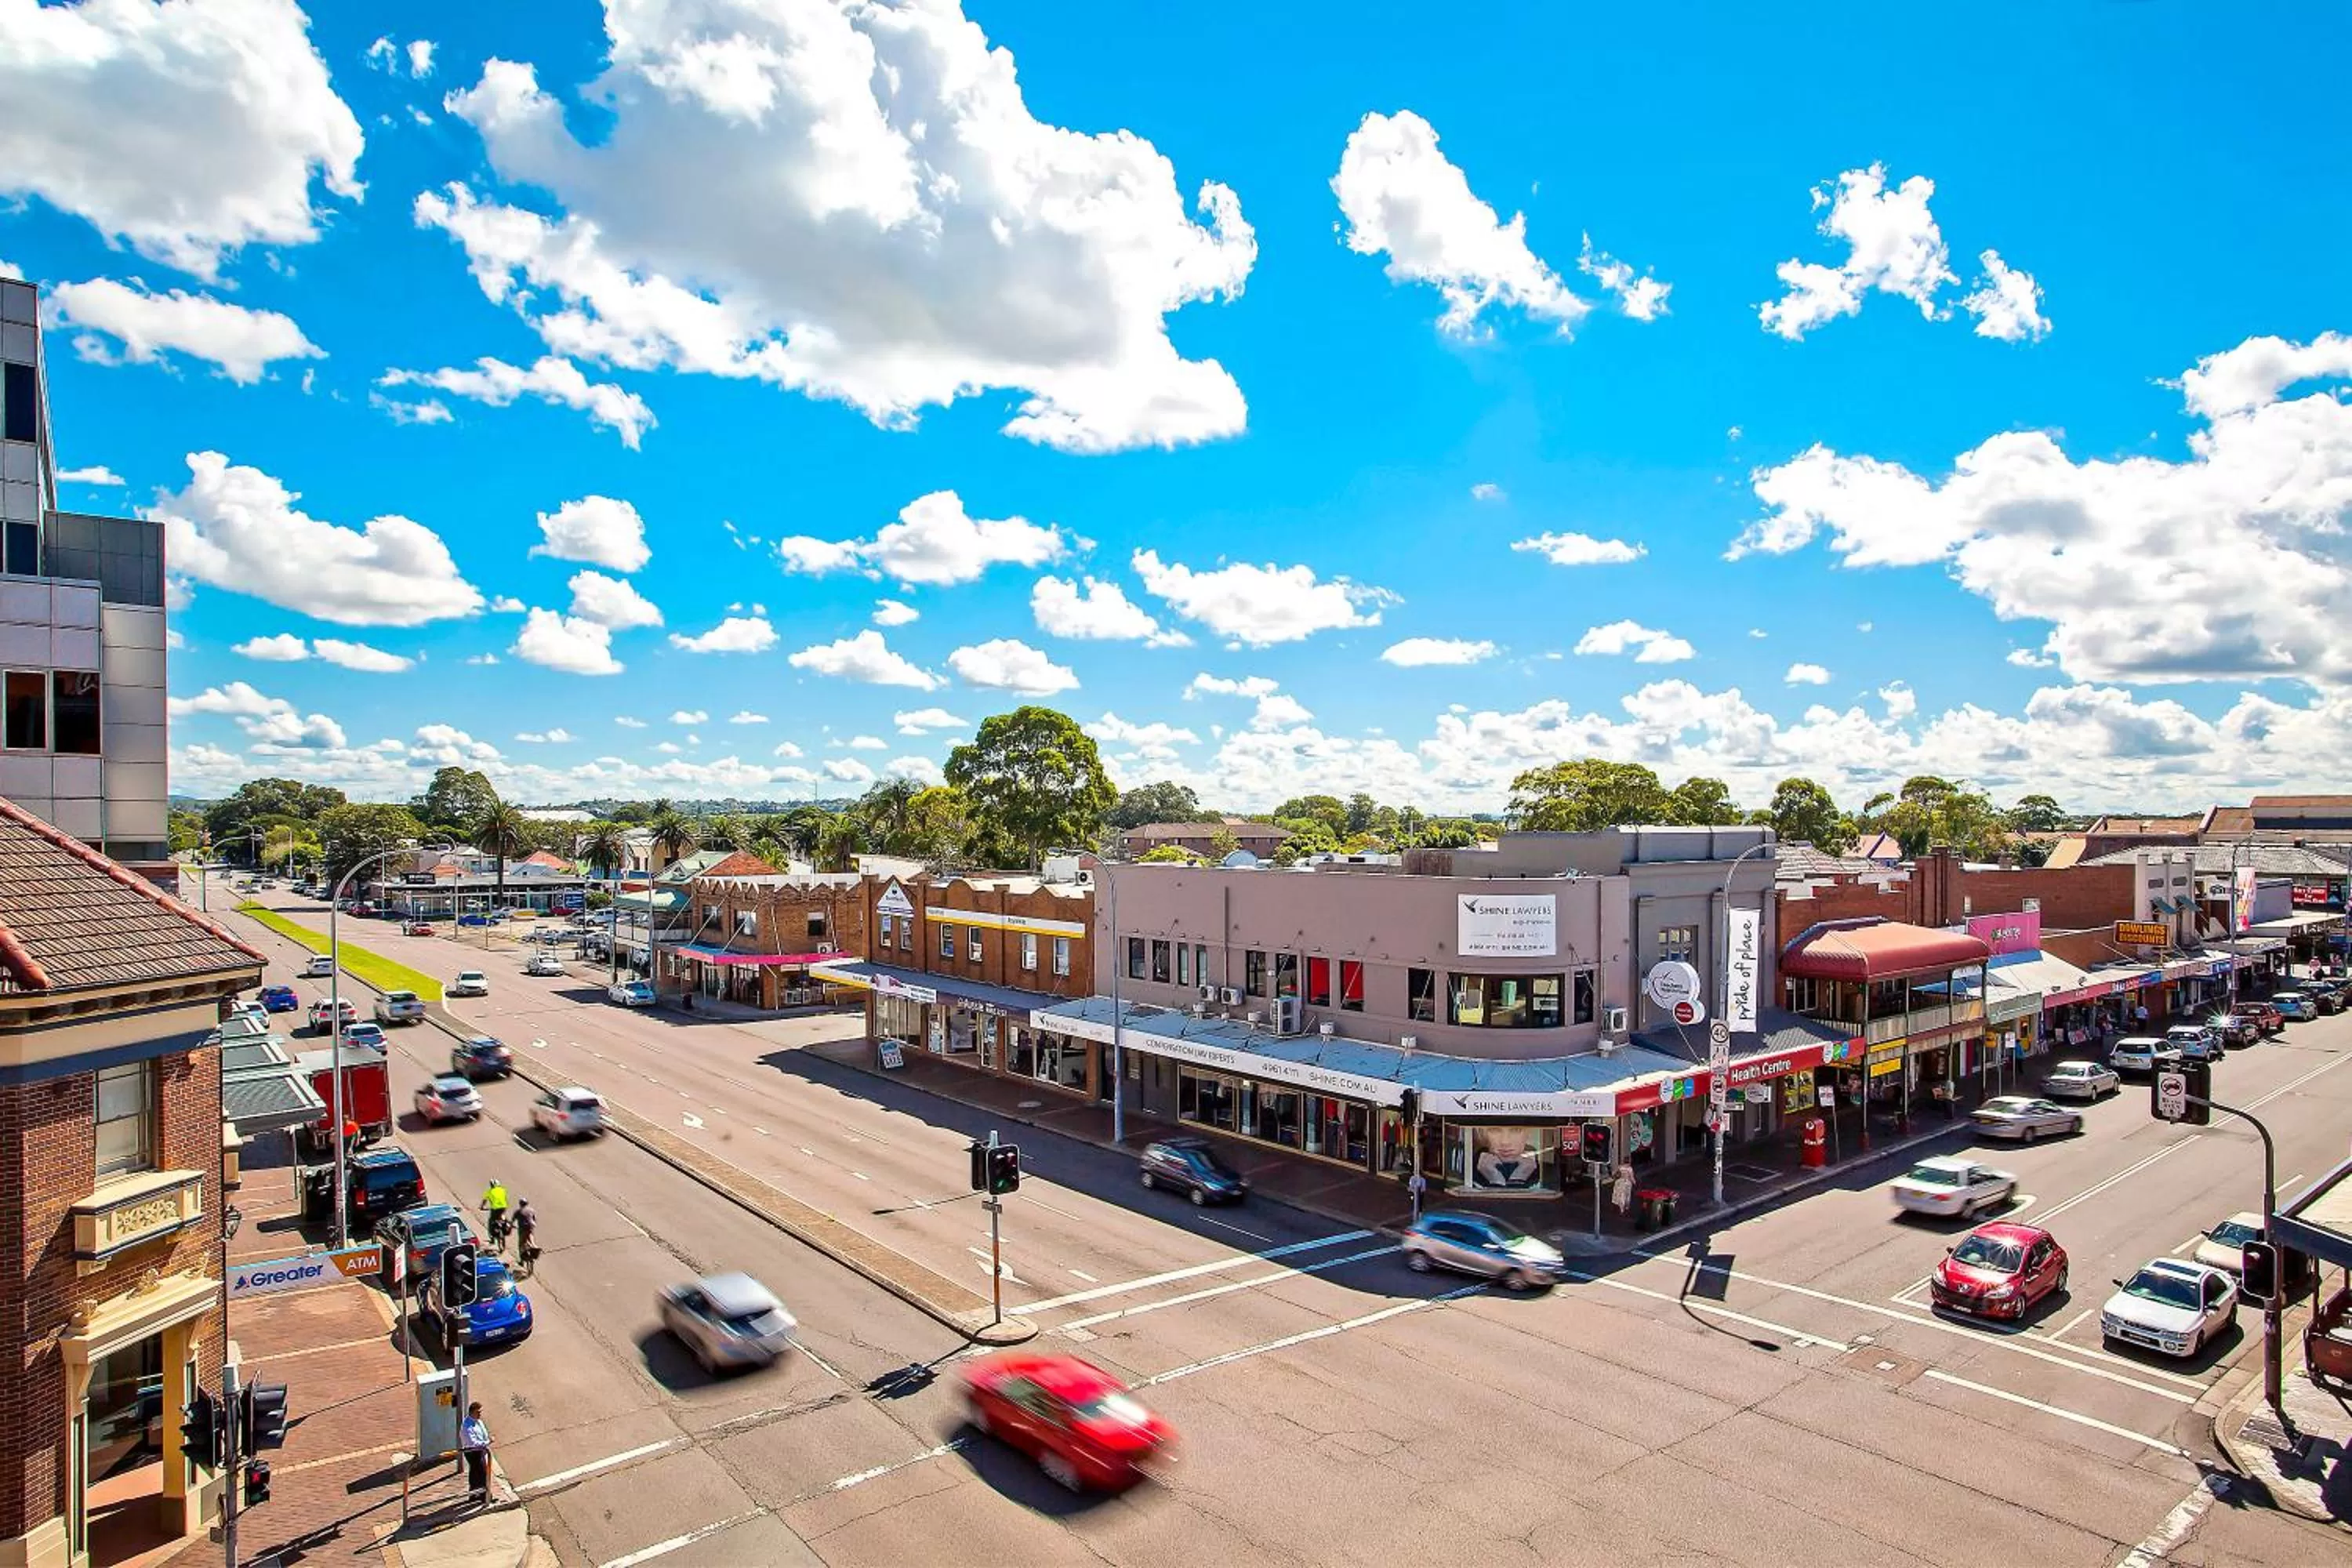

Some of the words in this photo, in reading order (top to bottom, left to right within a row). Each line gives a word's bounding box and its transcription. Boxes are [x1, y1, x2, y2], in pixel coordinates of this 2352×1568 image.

[1479, 906, 1508, 915] SHINE
[1512, 906, 1552, 915] LAWYERS
[2119, 923, 2165, 935] DOWLINGS
[1735, 918, 1757, 960] place
[2119, 933, 2165, 945] DISCOUNTS
[1733, 962, 1752, 978] of
[1733, 981, 1756, 1020] pride
[1731, 1063, 1760, 1083] Health
[1763, 1059, 1791, 1075] Centre
[1309, 1072, 1377, 1094] SHINE.COM.AU
[1473, 1102, 1505, 1111] SHINE
[1508, 1102, 1553, 1112] LAWYERS
[250, 1264, 323, 1287] Greater
[346, 1254, 377, 1271] ATM
